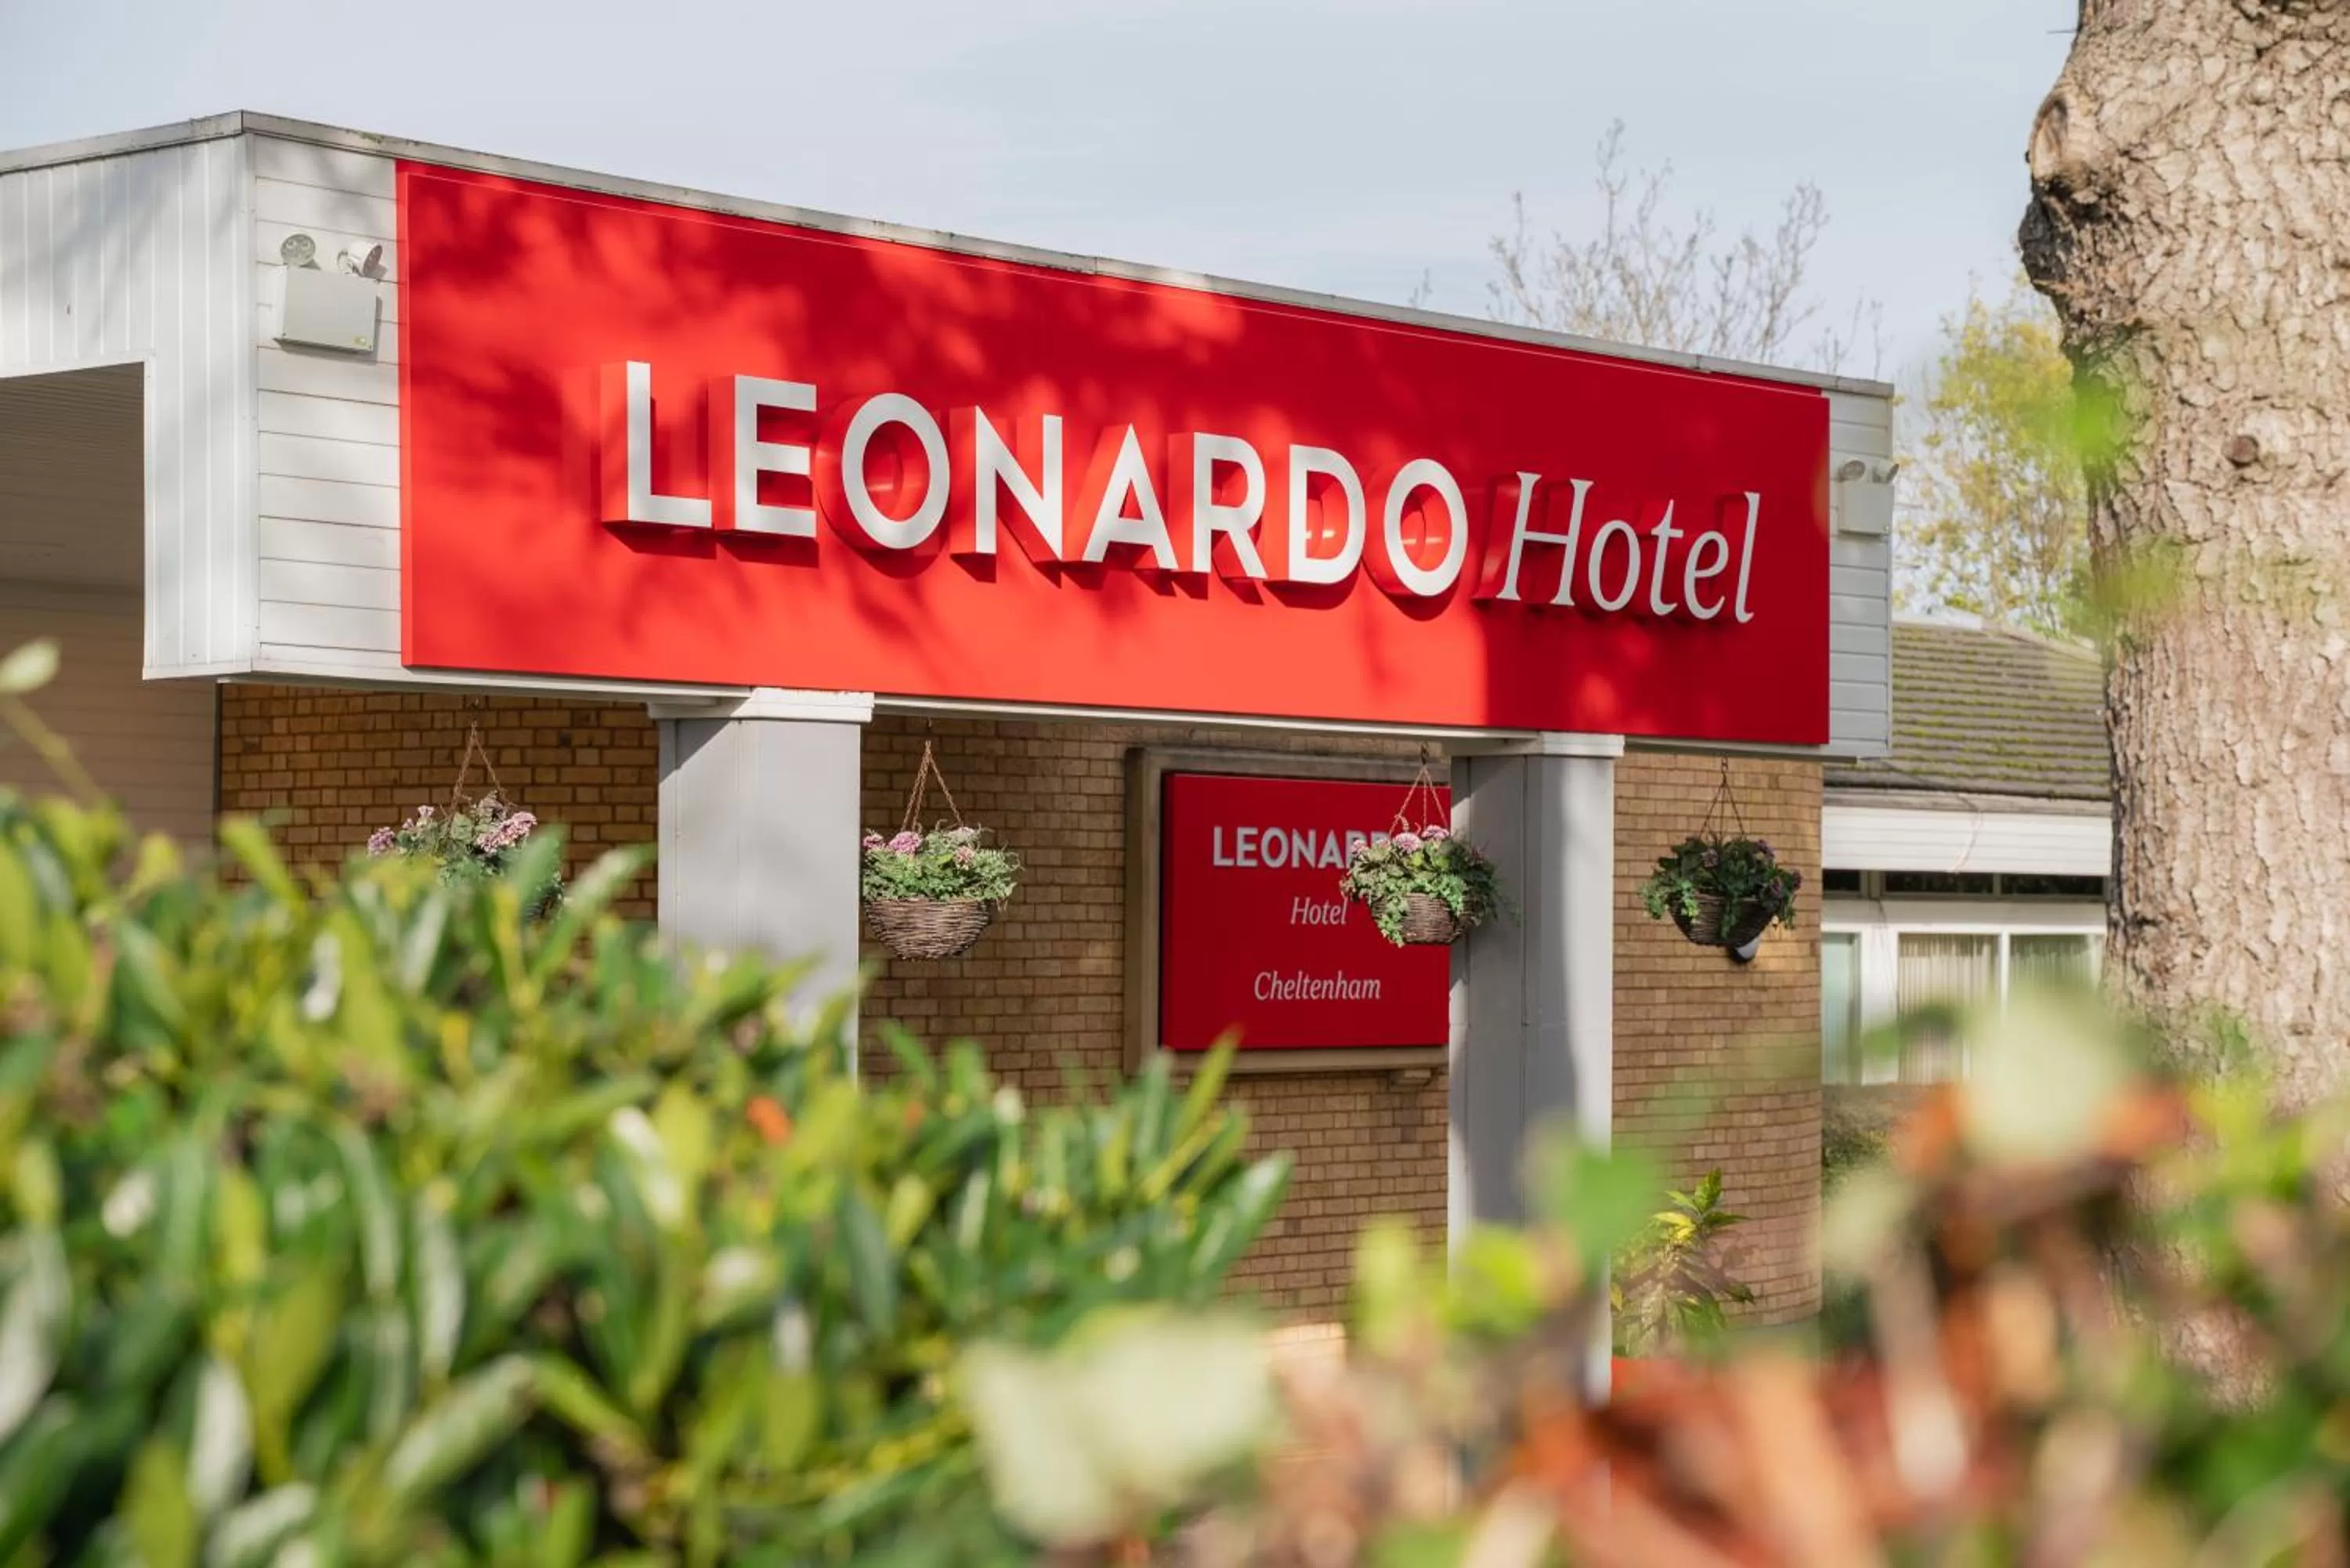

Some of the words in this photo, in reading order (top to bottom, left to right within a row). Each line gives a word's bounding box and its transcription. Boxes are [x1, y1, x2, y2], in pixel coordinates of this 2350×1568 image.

[627, 360, 1468, 597] LEONARDO
[1496, 471, 1760, 623] Hotel
[1213, 826, 1391, 869] LEONAR
[1290, 896, 1348, 925] Hotel
[1253, 971, 1381, 1000] Cheltenham
